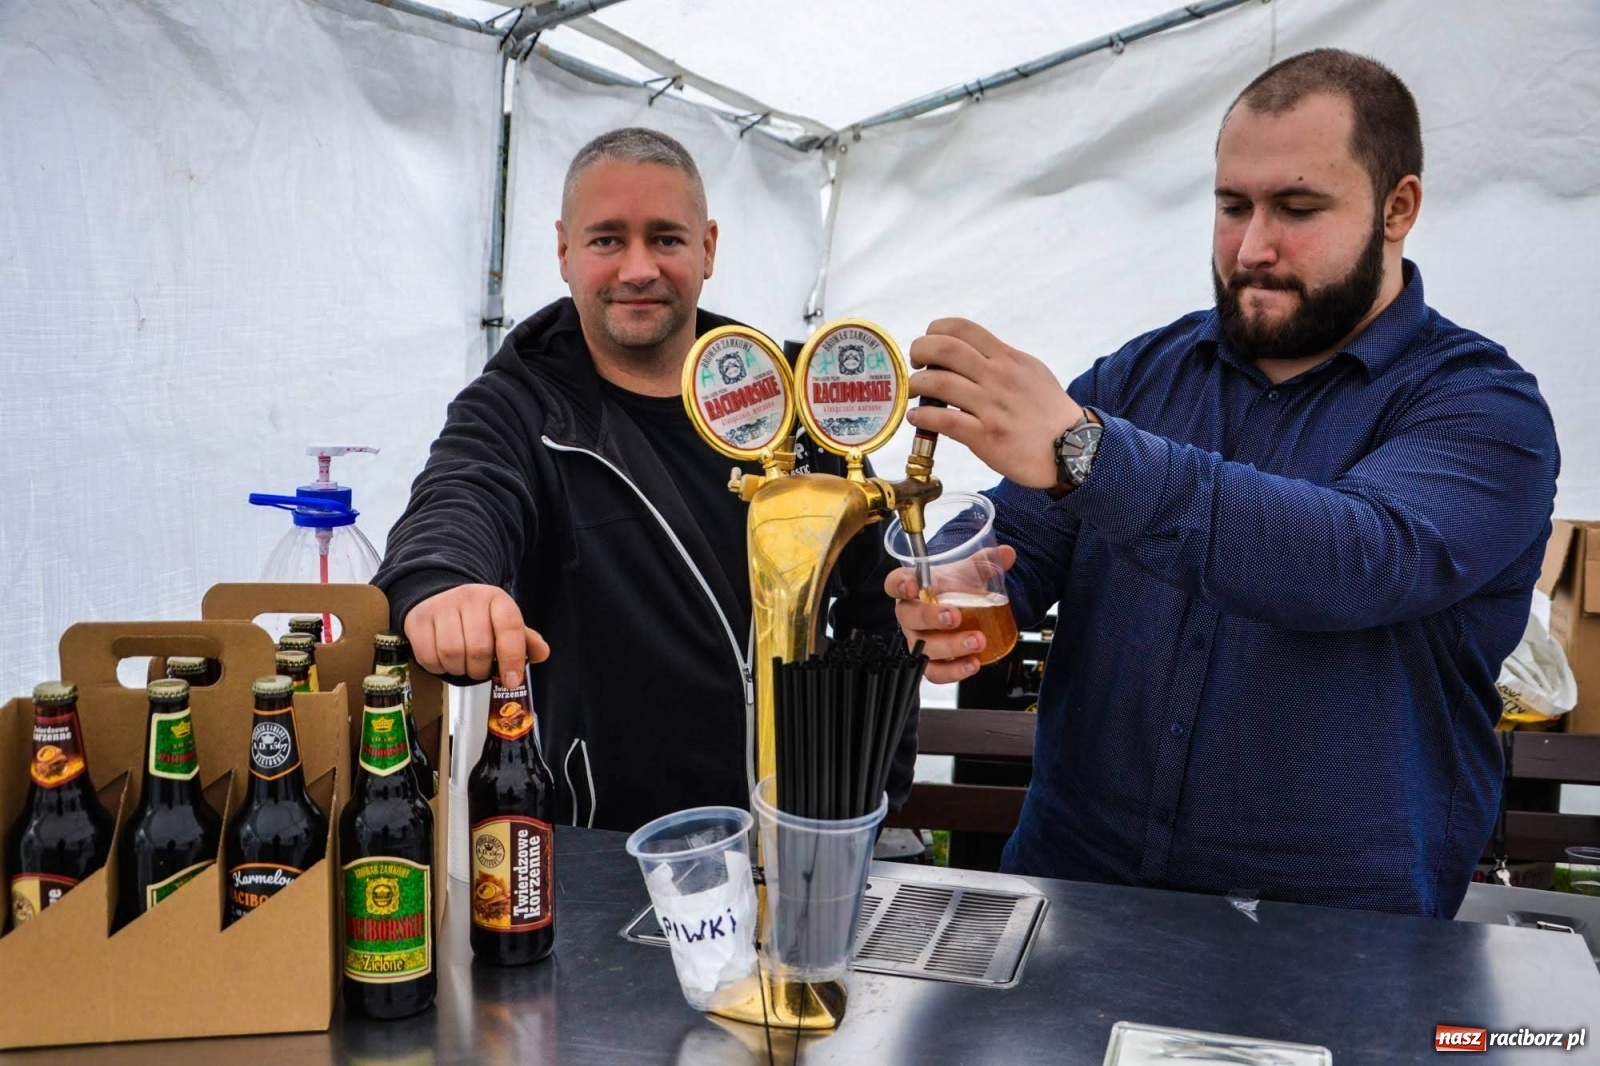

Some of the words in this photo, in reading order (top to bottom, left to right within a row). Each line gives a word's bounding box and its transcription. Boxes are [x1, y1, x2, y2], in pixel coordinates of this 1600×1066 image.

[701, 340, 721, 369] BROWAR
[722, 338, 753, 352] ZAMKOWY
[822, 330, 848, 352] BROWAR
[849, 330, 880, 350] ZAMKOWY
[493, 689, 528, 699] korzenne
[513, 829, 529, 917] Twierdzowe
[524, 835, 541, 919] korzenne
[363, 954, 405, 972] Zielone
